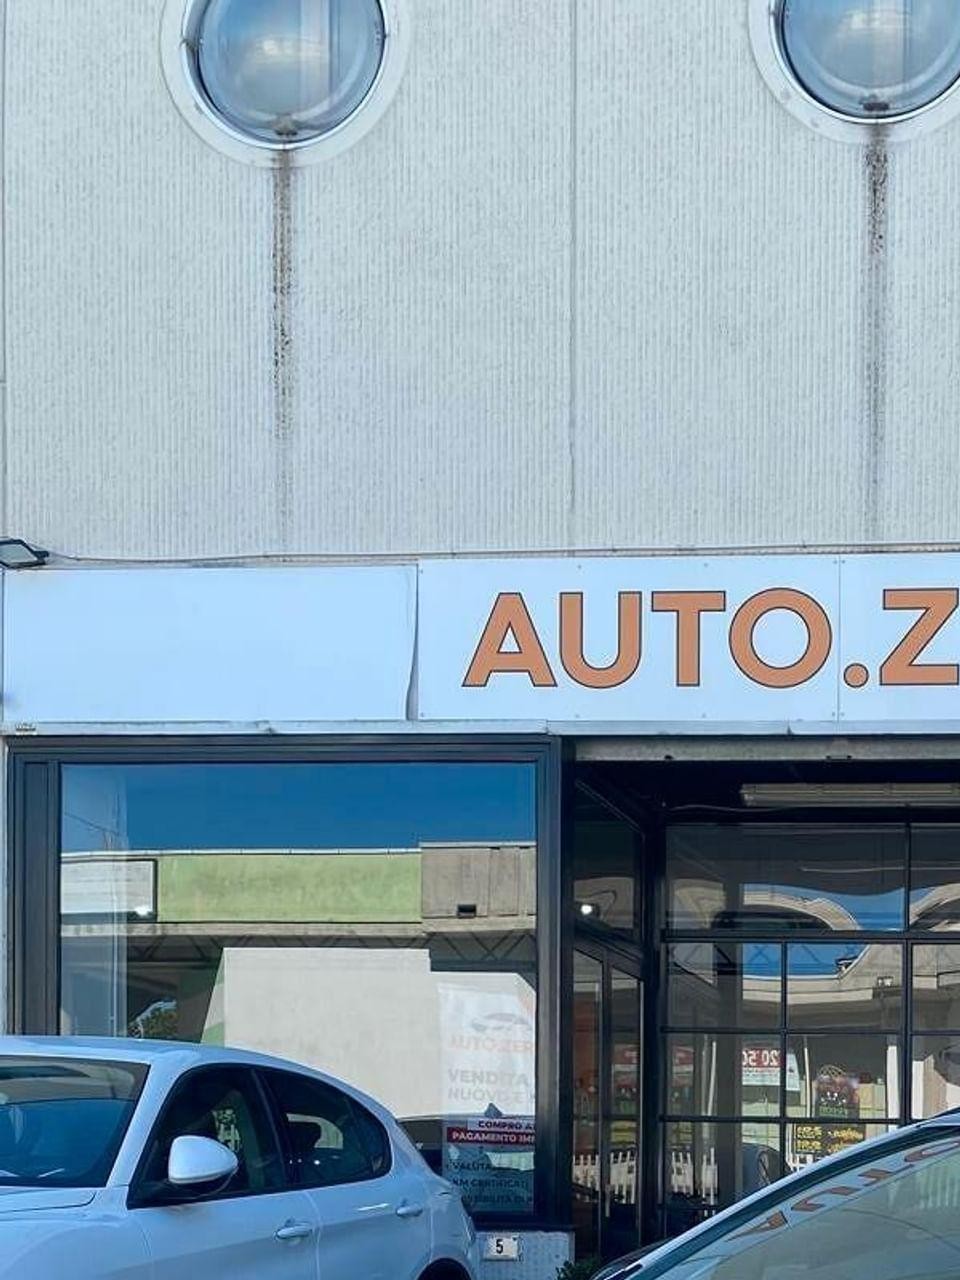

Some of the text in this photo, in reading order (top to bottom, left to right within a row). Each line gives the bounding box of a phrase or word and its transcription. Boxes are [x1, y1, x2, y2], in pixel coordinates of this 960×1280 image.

[448, 1069, 530, 1088] VENDITA
[478, 1120, 522, 1130] COMPRO
[452, 1132, 516, 1142] PAGAMENTO
[495, 1238, 504, 1254] 5
